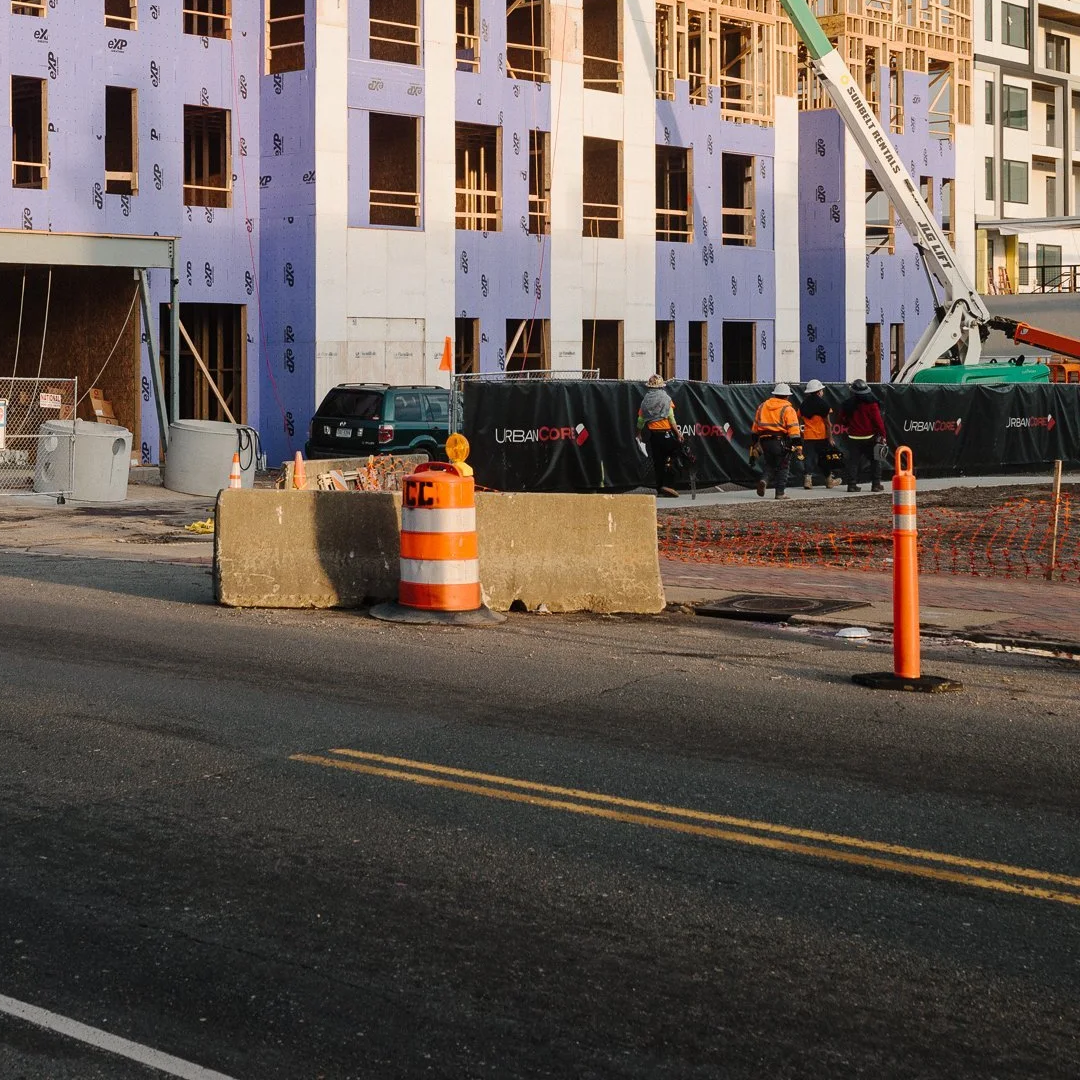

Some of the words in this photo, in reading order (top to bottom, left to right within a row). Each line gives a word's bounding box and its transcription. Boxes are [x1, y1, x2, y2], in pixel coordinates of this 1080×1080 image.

[108, 38, 127, 50] eXP
[48, 52, 56, 80] eXP
[150, 61, 158, 87] eXP
[847, 86, 875, 130] SUNBELT
[872, 130, 900, 174] RENTALS
[153, 164, 162, 190] eXP
[94, 183, 102, 210] eXP
[818, 185, 826, 204] eXP
[832, 204, 840, 223] eXP
[918, 222, 936, 242] JLG
[932, 245, 952, 269] LIFT
[286, 262, 294, 287] eXP
[807, 278, 815, 296] eXP
[286, 326, 295, 343] eX
[807, 324, 815, 342] eXP
[286, 348, 295, 373] eXP
[142, 376, 151, 402] eXP
[286, 412, 294, 436] eXP
[904, 420, 956, 432] URBANCORE
